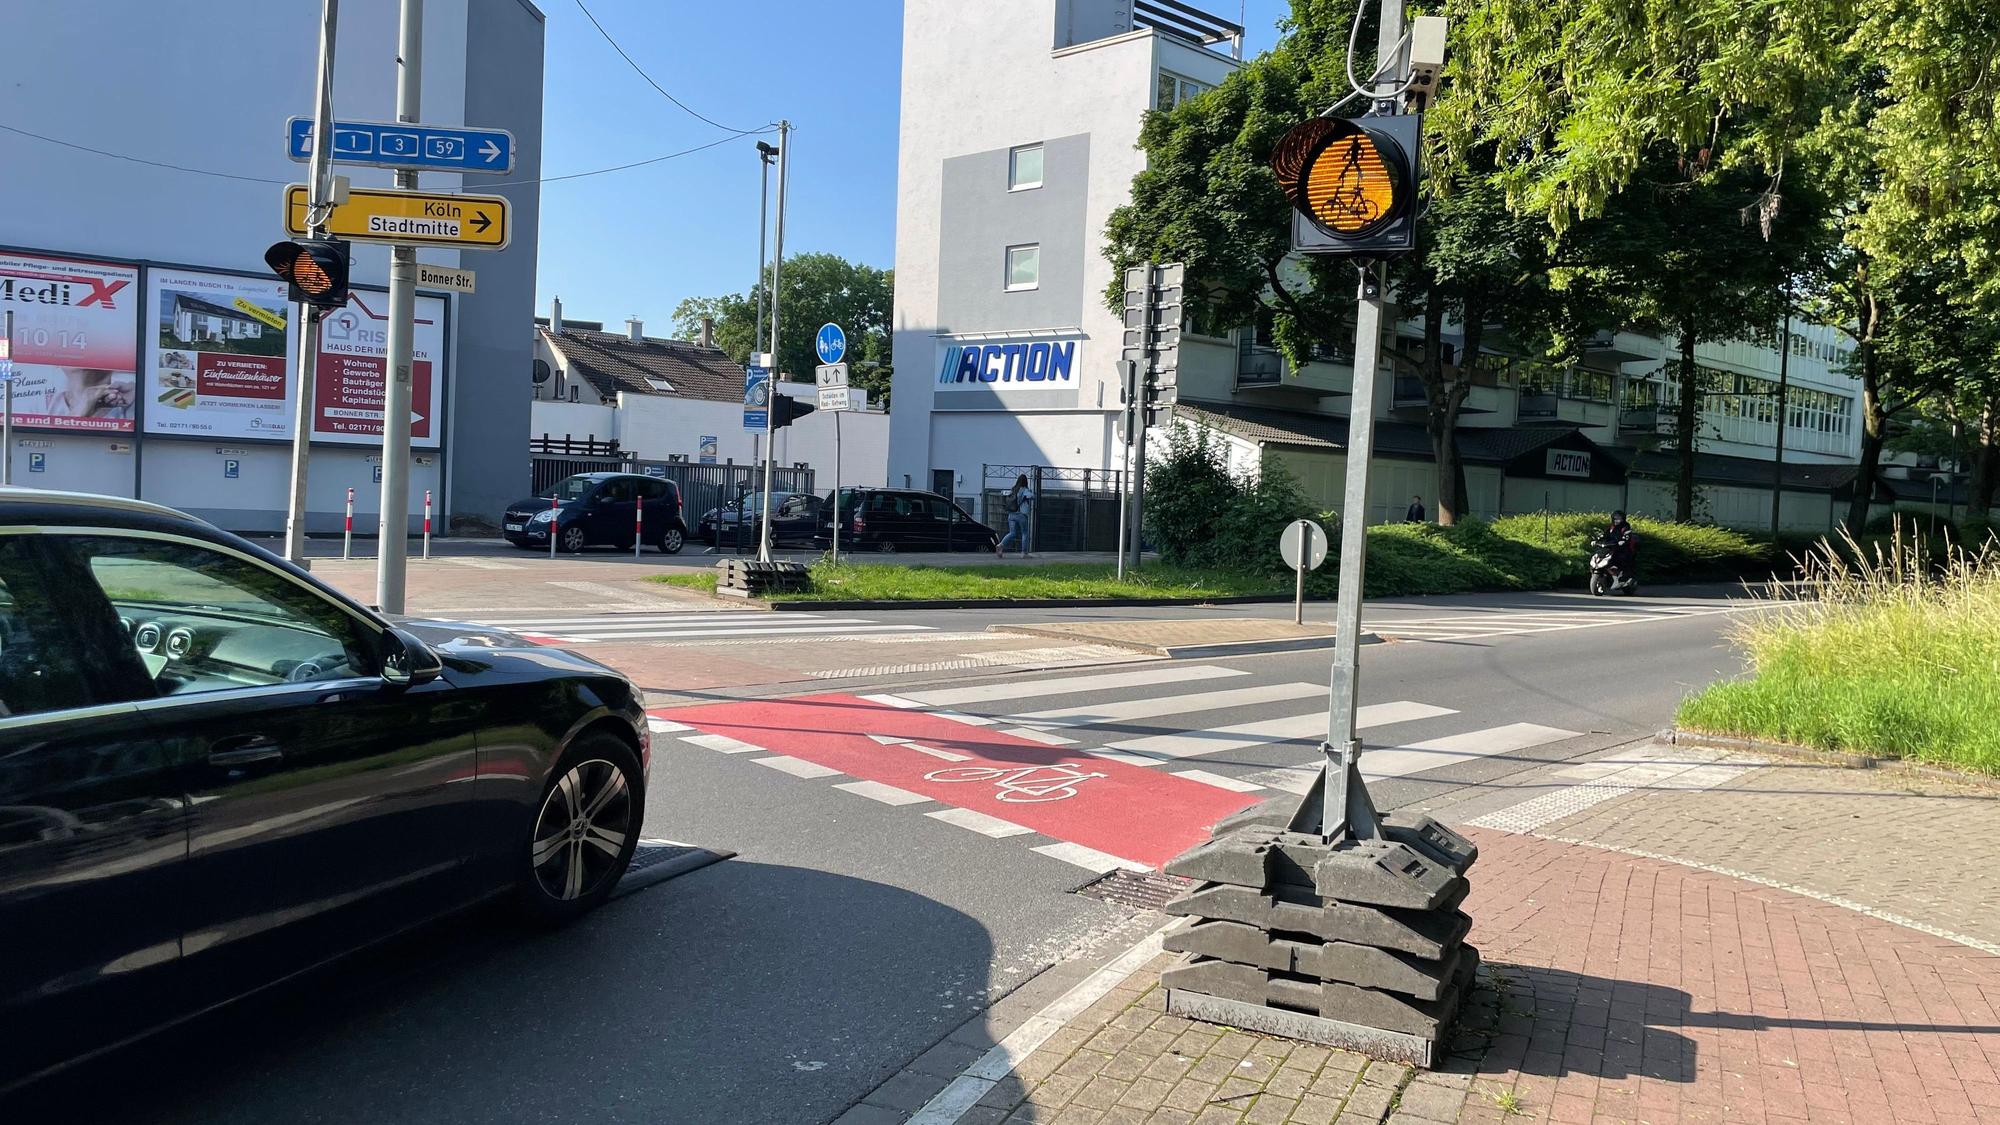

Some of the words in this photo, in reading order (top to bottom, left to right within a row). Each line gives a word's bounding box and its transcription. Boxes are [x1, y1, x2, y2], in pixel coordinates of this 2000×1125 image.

[350, 135, 357, 149] 1
[395, 138, 405, 152] 3
[436, 141, 454, 155] 59
[424, 201, 462, 218] Köln
[370, 216, 459, 236] Stadtmitte
[421, 269, 454, 286] Bonner
[456, 274, 472, 288] Str.
[236, 300, 248, 309] Zu
[248, 306, 283, 327] vermieten
[19, 327, 50, 347] 10
[58, 329, 88, 350] 14
[357, 329, 386, 343] RIS
[327, 343, 353, 352] HAUS
[354, 345, 374, 353] DER
[343, 359, 378, 369] Wohnen
[955, 341, 1076, 383] ACTION
[342, 368, 381, 378] Gewerbe
[342, 377, 384, 388] Bauträger
[342, 386, 386, 397] Grundstüc
[341, 395, 386, 405] Kapitalanl
[333, 409, 363, 417] BONNER
[26, 416, 51, 425] und
[54, 417, 119, 429] Betreuung
[333, 422, 347, 430] Tel.
[32, 454, 42, 466] P
[1553, 453, 1589, 472] ACTION
[226, 461, 237, 472] P
